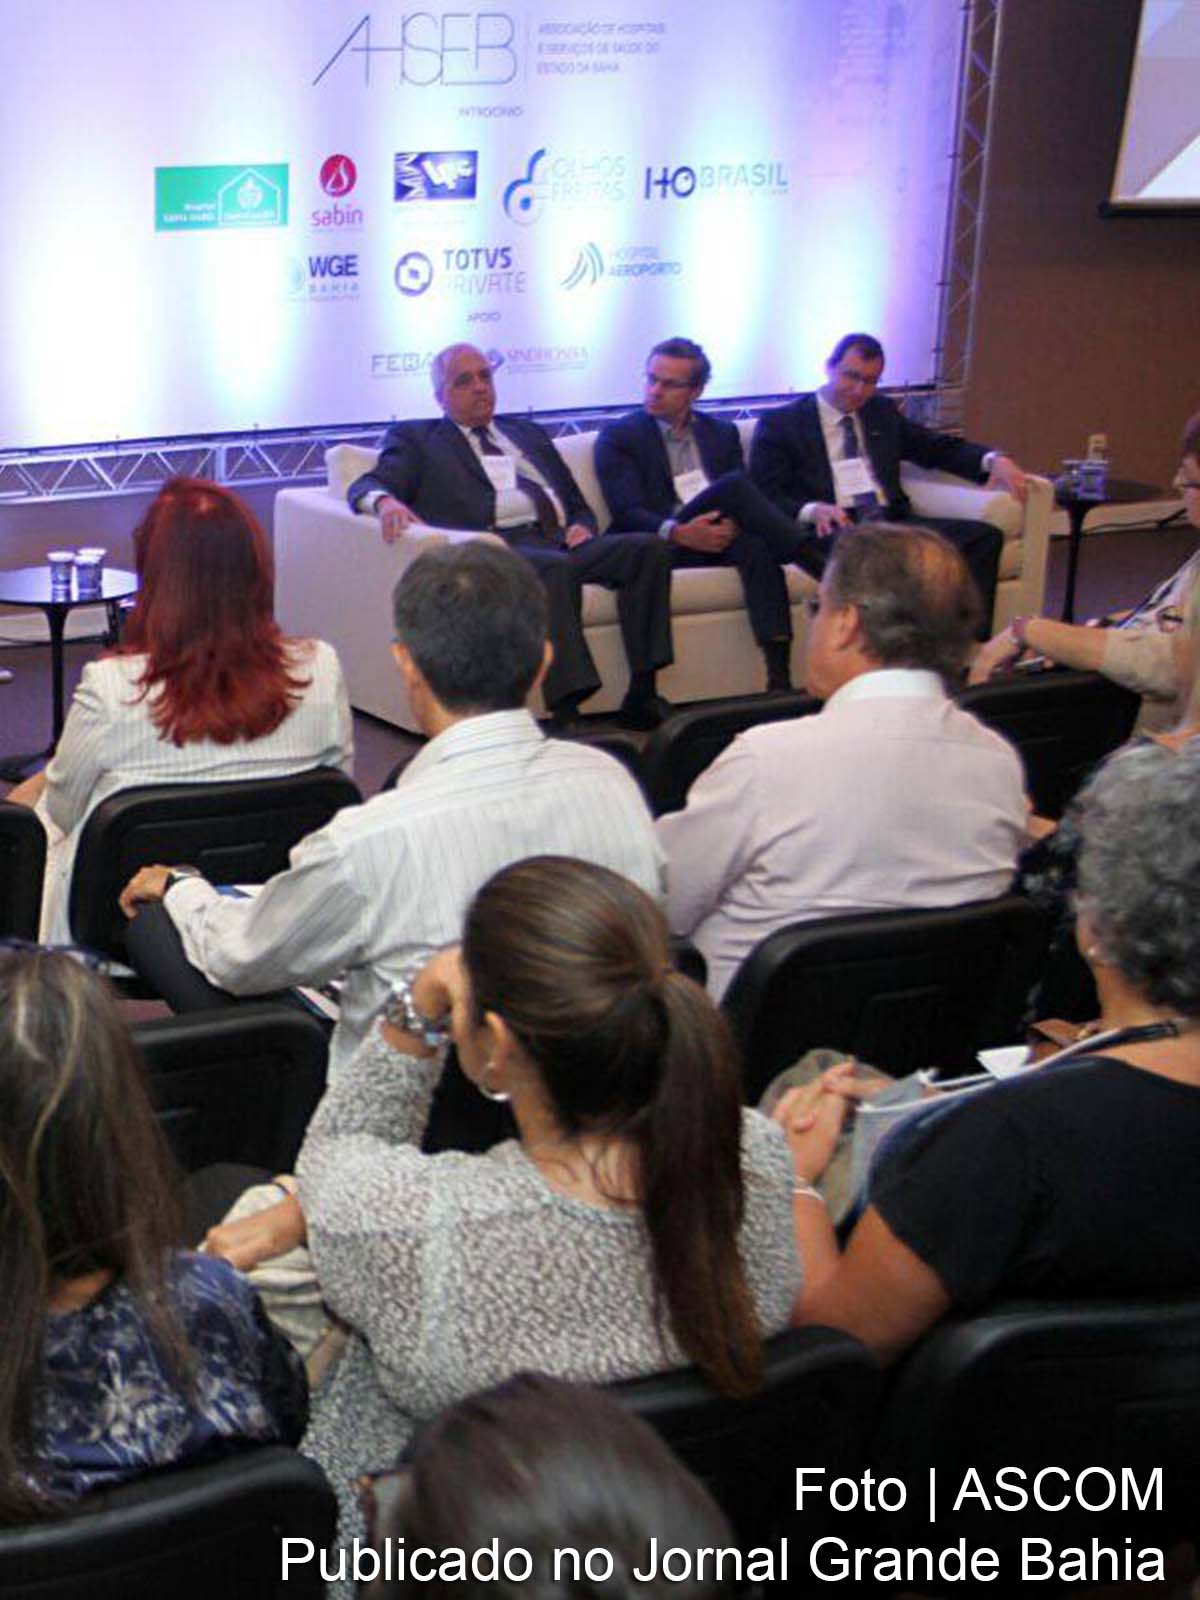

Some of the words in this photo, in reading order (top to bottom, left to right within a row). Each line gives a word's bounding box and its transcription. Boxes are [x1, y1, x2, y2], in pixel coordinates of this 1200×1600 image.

[311, 203, 363, 227] sabin
[308, 254, 359, 278] WGE
[443, 246, 513, 272] TOTVS
